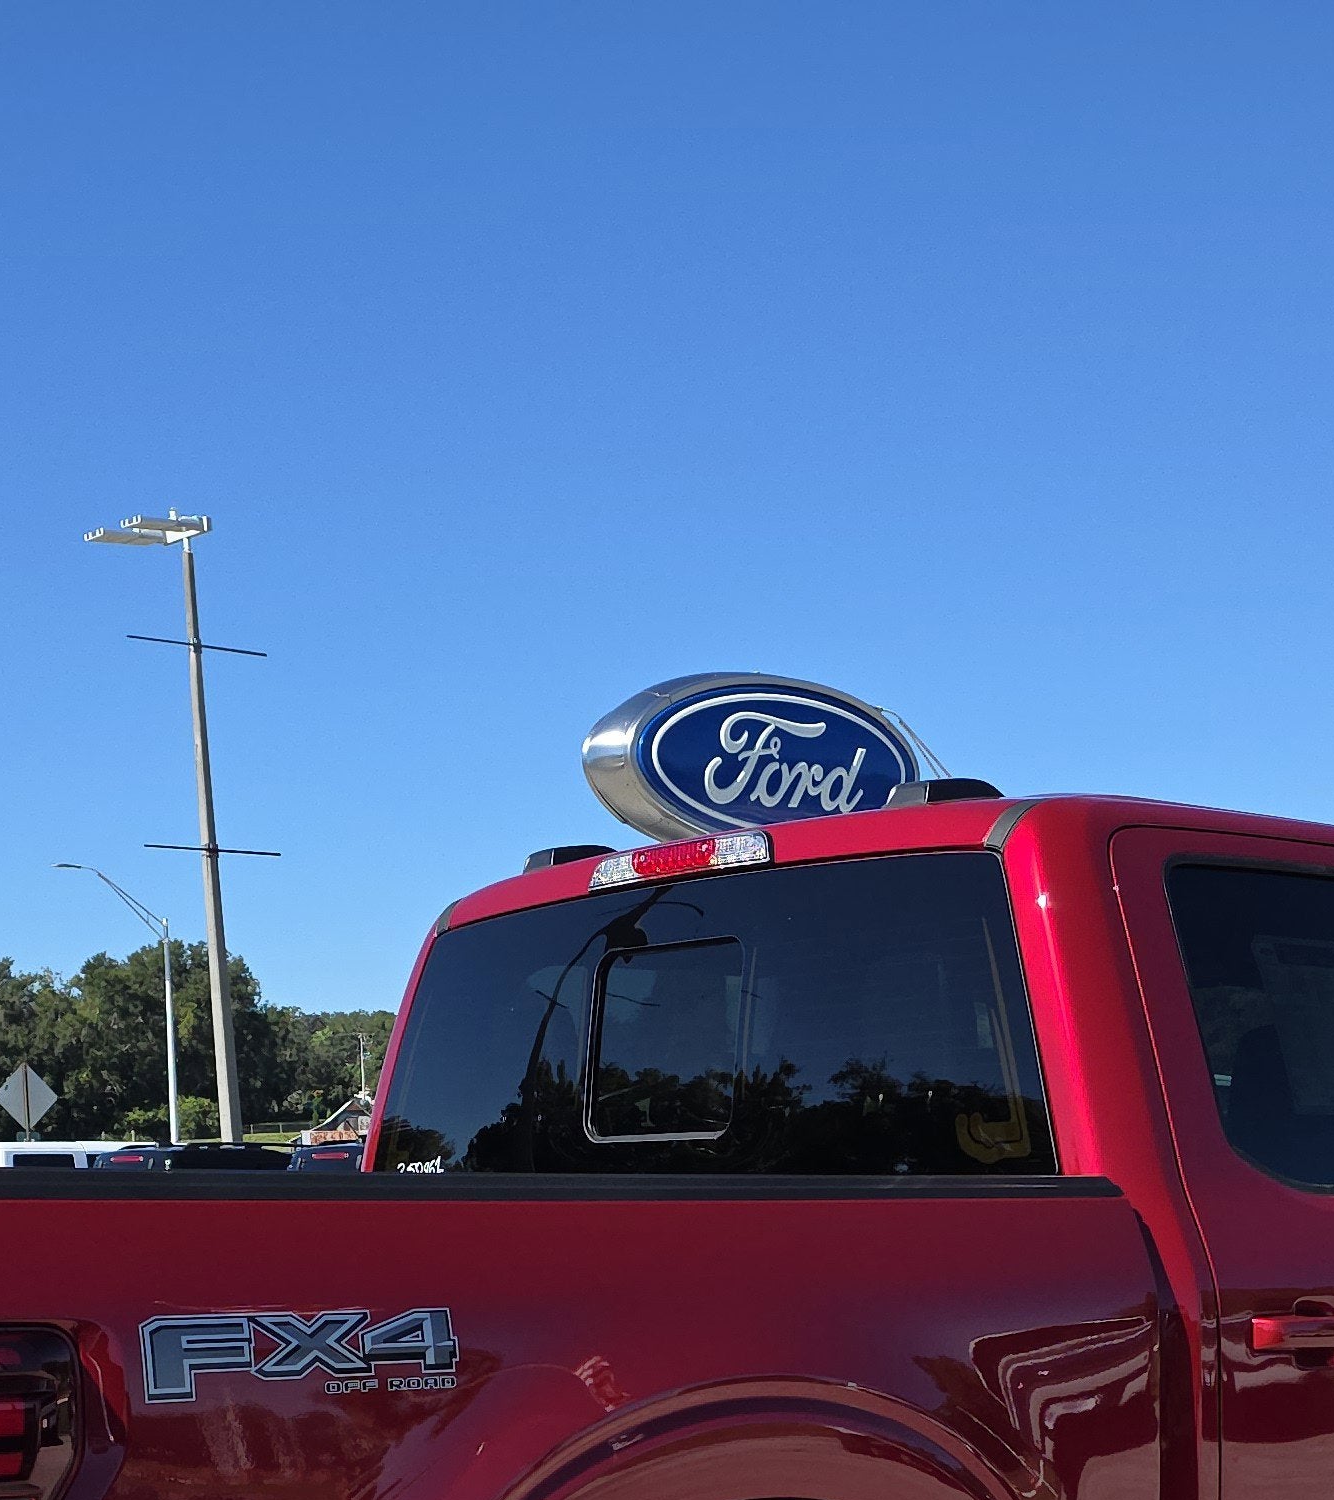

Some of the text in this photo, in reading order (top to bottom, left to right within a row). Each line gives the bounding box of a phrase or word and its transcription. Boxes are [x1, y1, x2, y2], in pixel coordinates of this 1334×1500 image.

[704, 711, 867, 814] Ford
[139, 1308, 459, 1403] FX4
[324, 1376, 457, 1395] OFF ROAD
